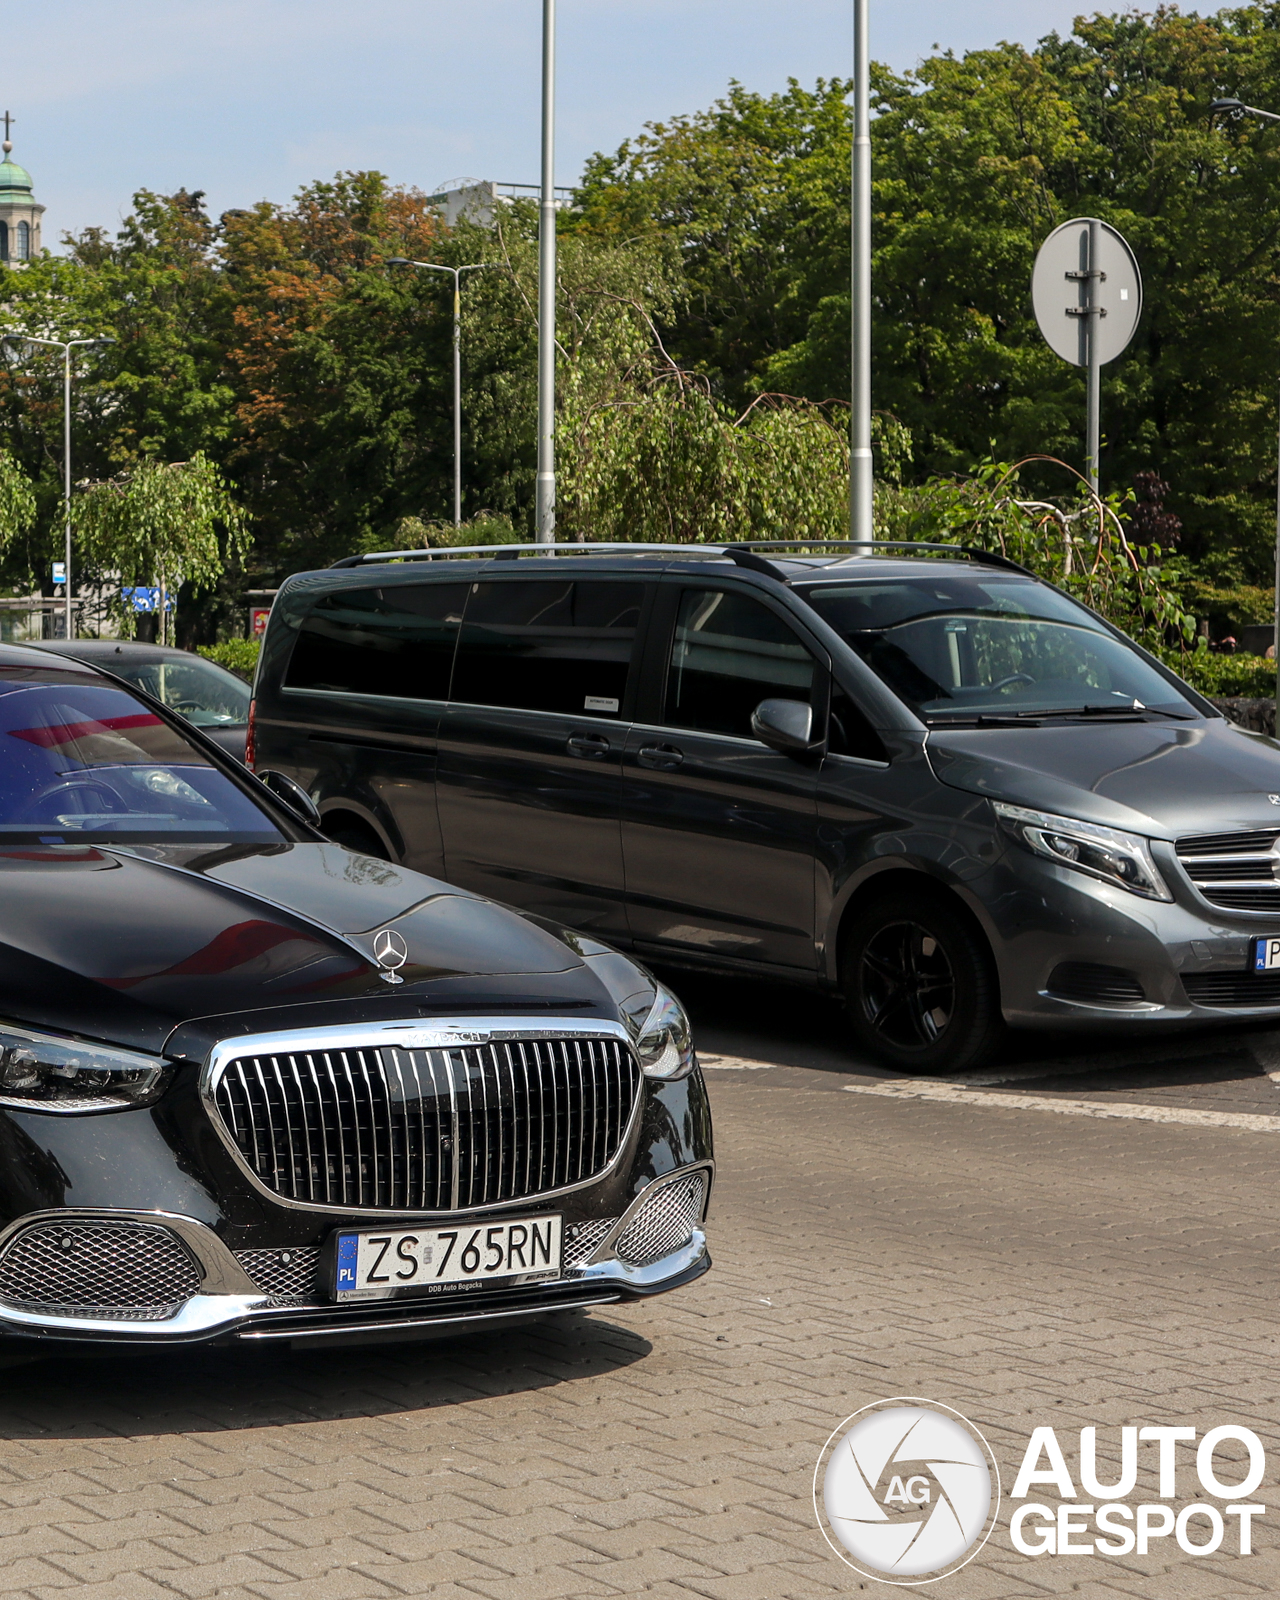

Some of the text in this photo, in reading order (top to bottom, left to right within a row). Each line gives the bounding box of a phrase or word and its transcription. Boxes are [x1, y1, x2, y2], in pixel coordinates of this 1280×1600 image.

[1270, 941, 1280, 965] P
[1257, 958, 1264, 966] PL
[407, 1031, 480, 1042] MAYBACH
[366, 1221, 552, 1283] ZS 765RN
[339, 1268, 354, 1281] PL
[428, 1285, 442, 1293] DDB
[443, 1284, 456, 1292] Auto
